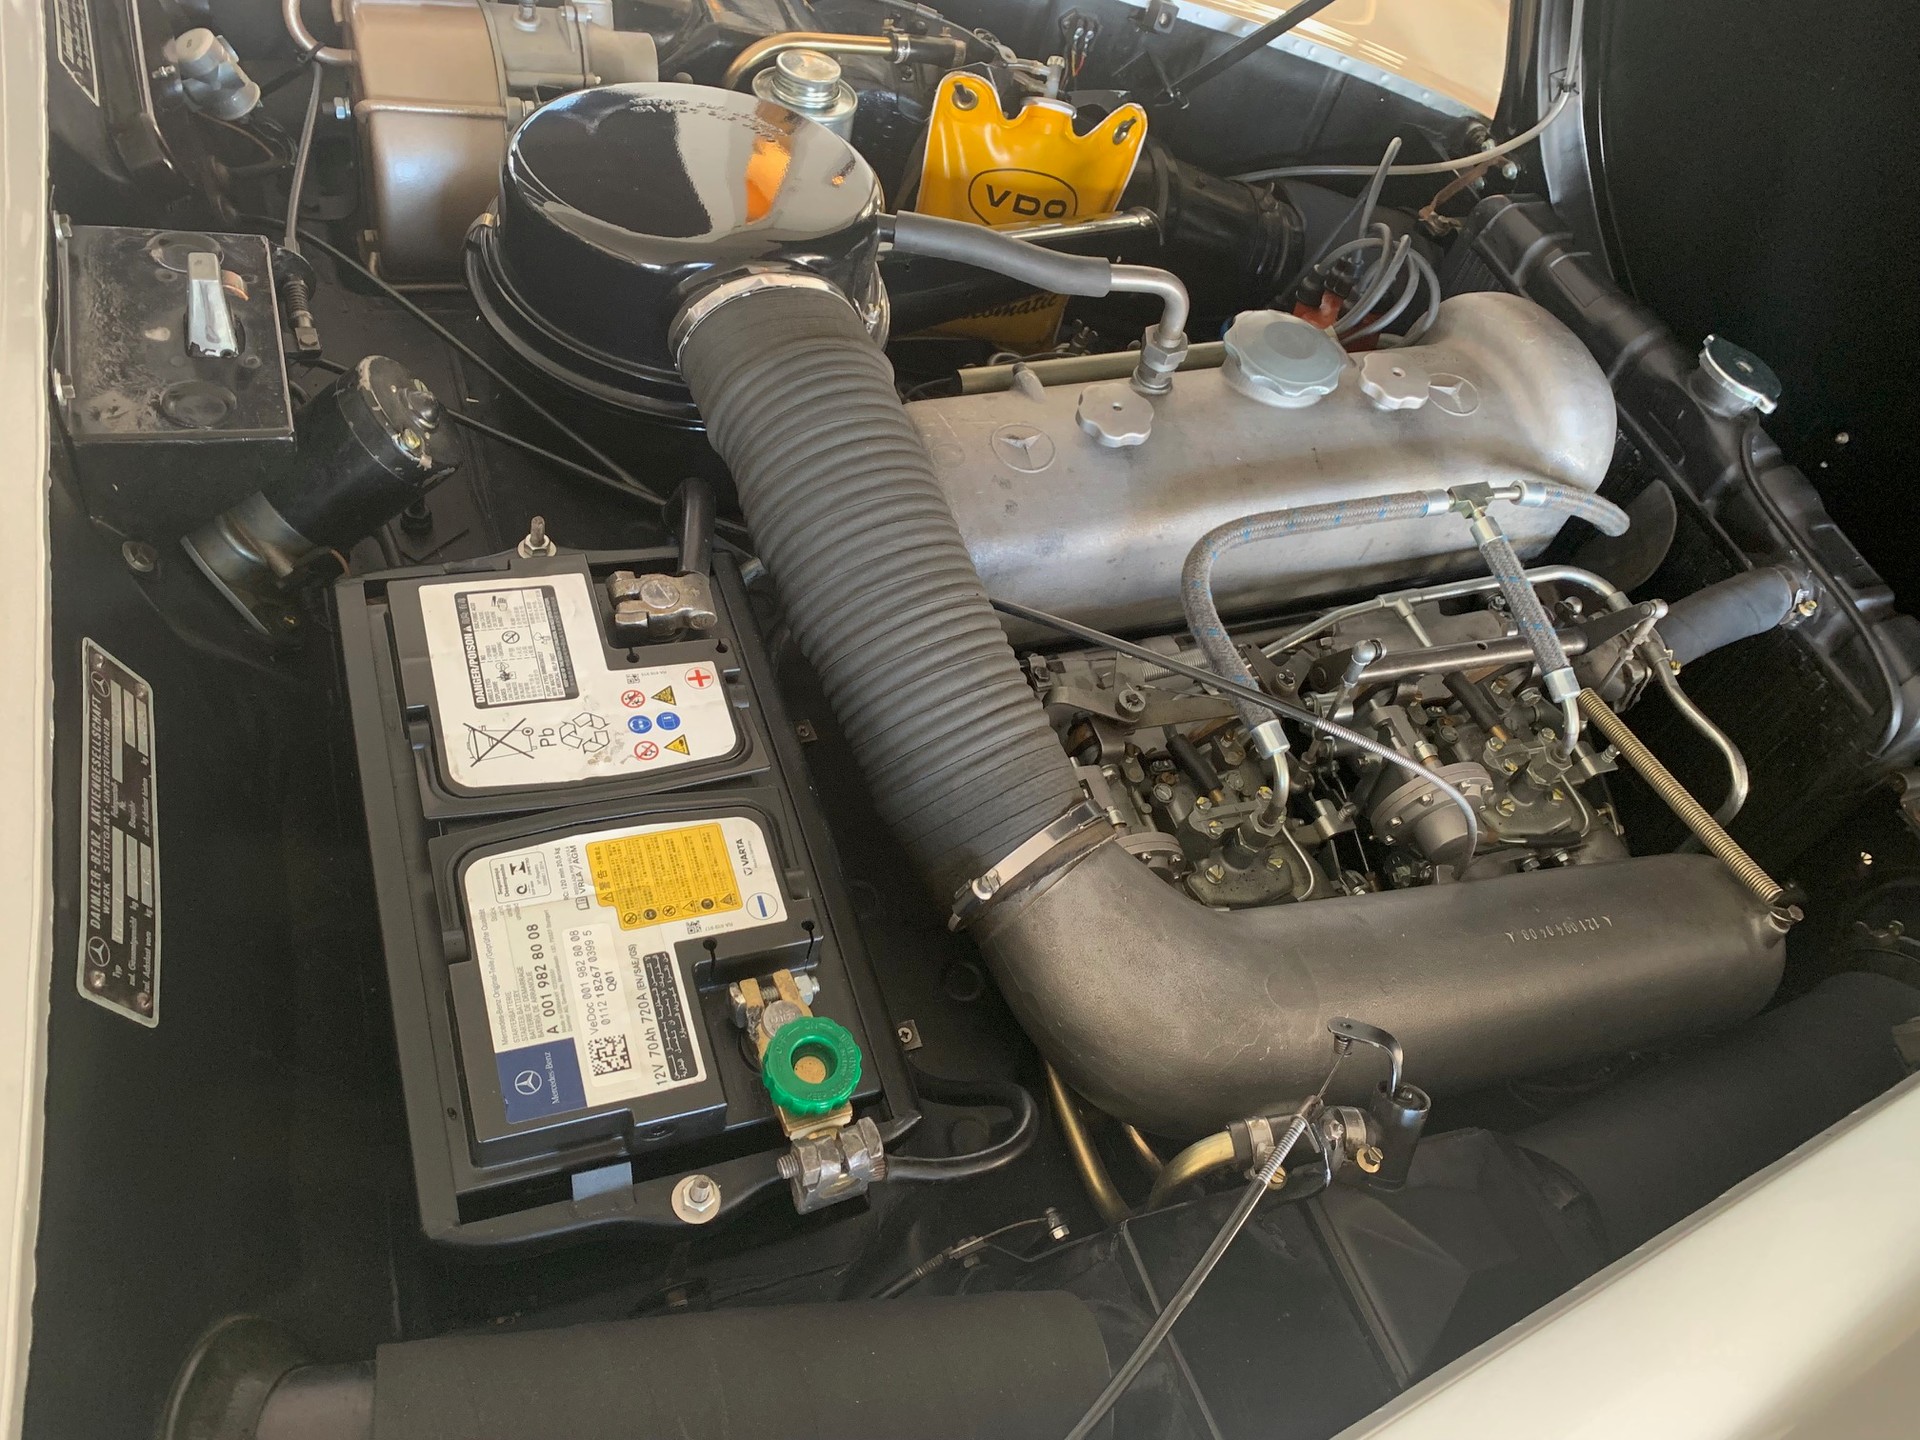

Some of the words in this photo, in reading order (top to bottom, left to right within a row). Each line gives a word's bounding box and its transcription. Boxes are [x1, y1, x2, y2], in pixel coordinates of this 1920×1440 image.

[986, 183, 1067, 219] VDO
[465, 634, 485, 702] DANGER/POISON
[540, 727, 556, 748] Pb
[91, 695, 101, 825] AKTIENGESELLSCHAFT
[570, 845, 579, 864] AGM
[736, 839, 749, 866] VARTA
[91, 831, 101, 928] DAIMLER-BENZ
[527, 924, 540, 939] 08
[569, 930, 580, 941] 08
[530, 944, 544, 960] 80
[572, 945, 583, 956] 80
[584, 940, 597, 962] 0399
[113, 965, 122, 978] Typ
[535, 964, 549, 988] 982
[576, 960, 587, 978] 982
[580, 982, 592, 999] 001
[590, 966, 604, 997] 18267
[605, 971, 617, 991] Q01
[541, 994, 555, 1017] 001
[597, 1001, 611, 1025] 0112
[637, 993, 652, 1023] 720A
[547, 1025, 559, 1034] A
[586, 1002, 598, 1035] VeDoc
[645, 1027, 660, 1057] 70Ah
[545, 1052, 559, 1104] Mercedes-Benz
[652, 1064, 667, 1085] 12V
